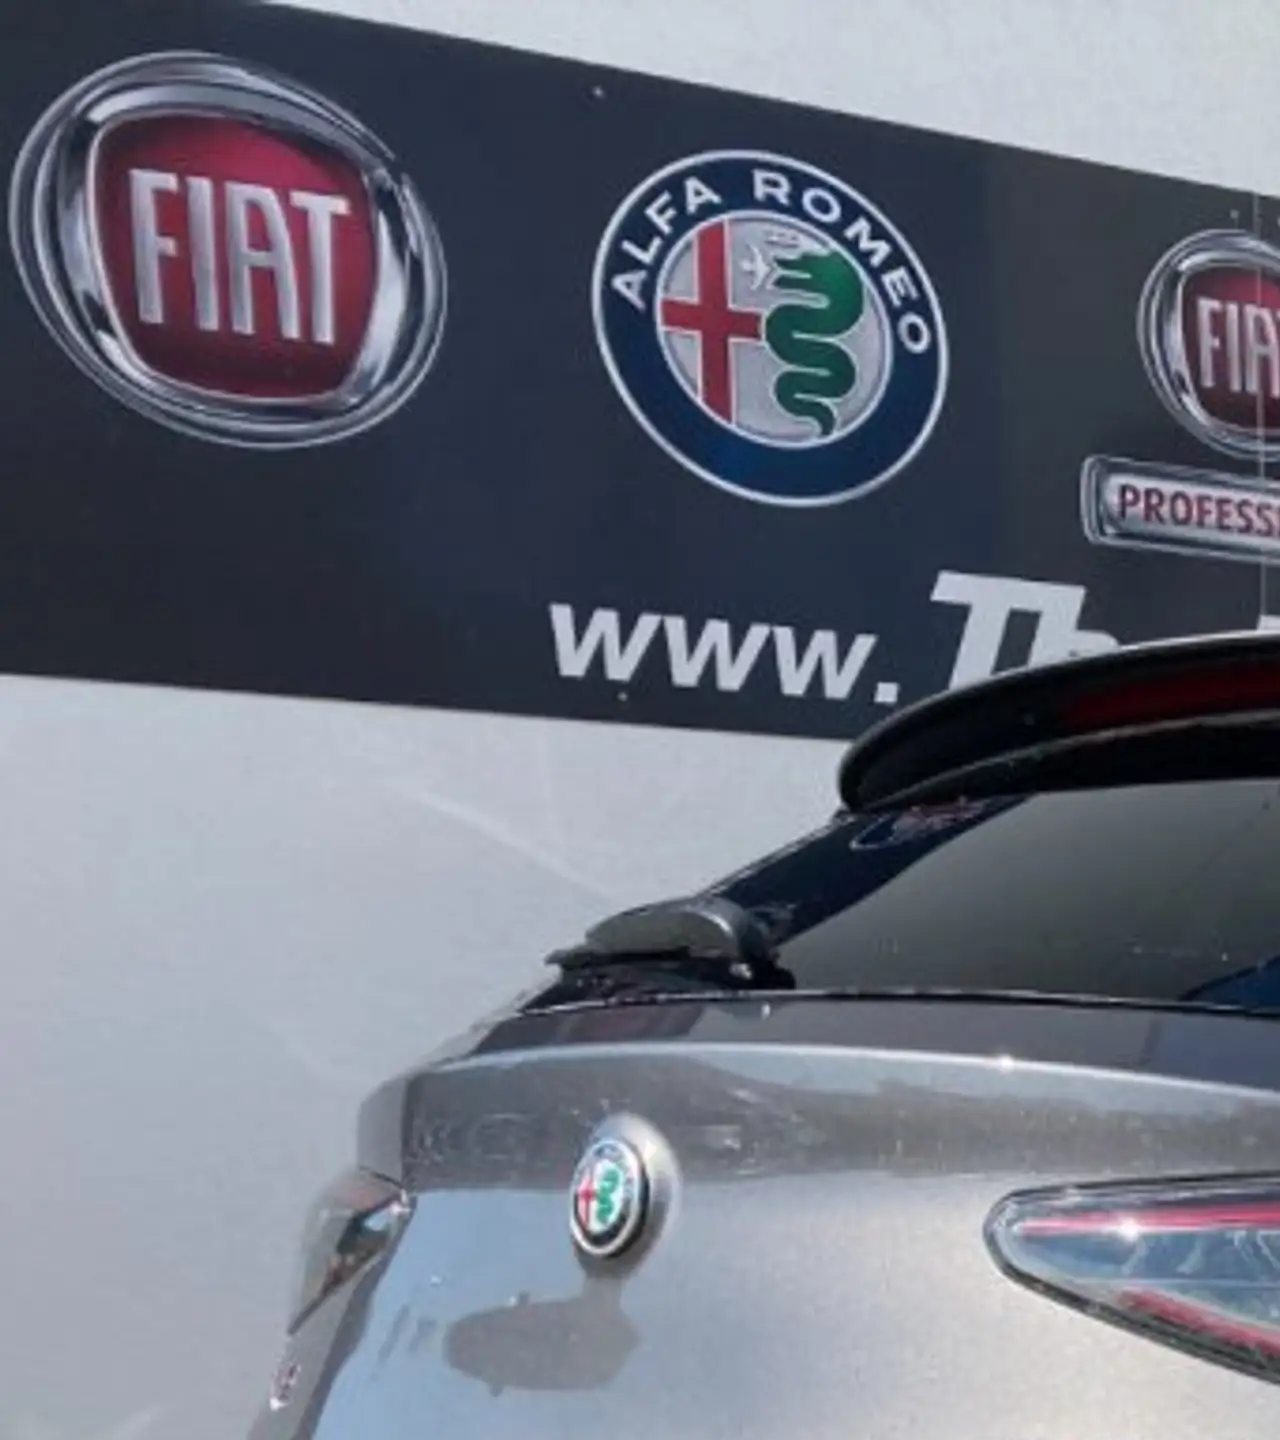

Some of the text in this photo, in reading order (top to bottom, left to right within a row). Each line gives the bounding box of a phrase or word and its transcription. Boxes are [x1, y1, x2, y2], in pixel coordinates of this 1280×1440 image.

[129, 168, 350, 345] FIAT
[611, 168, 930, 355] ALFA ROMEO
